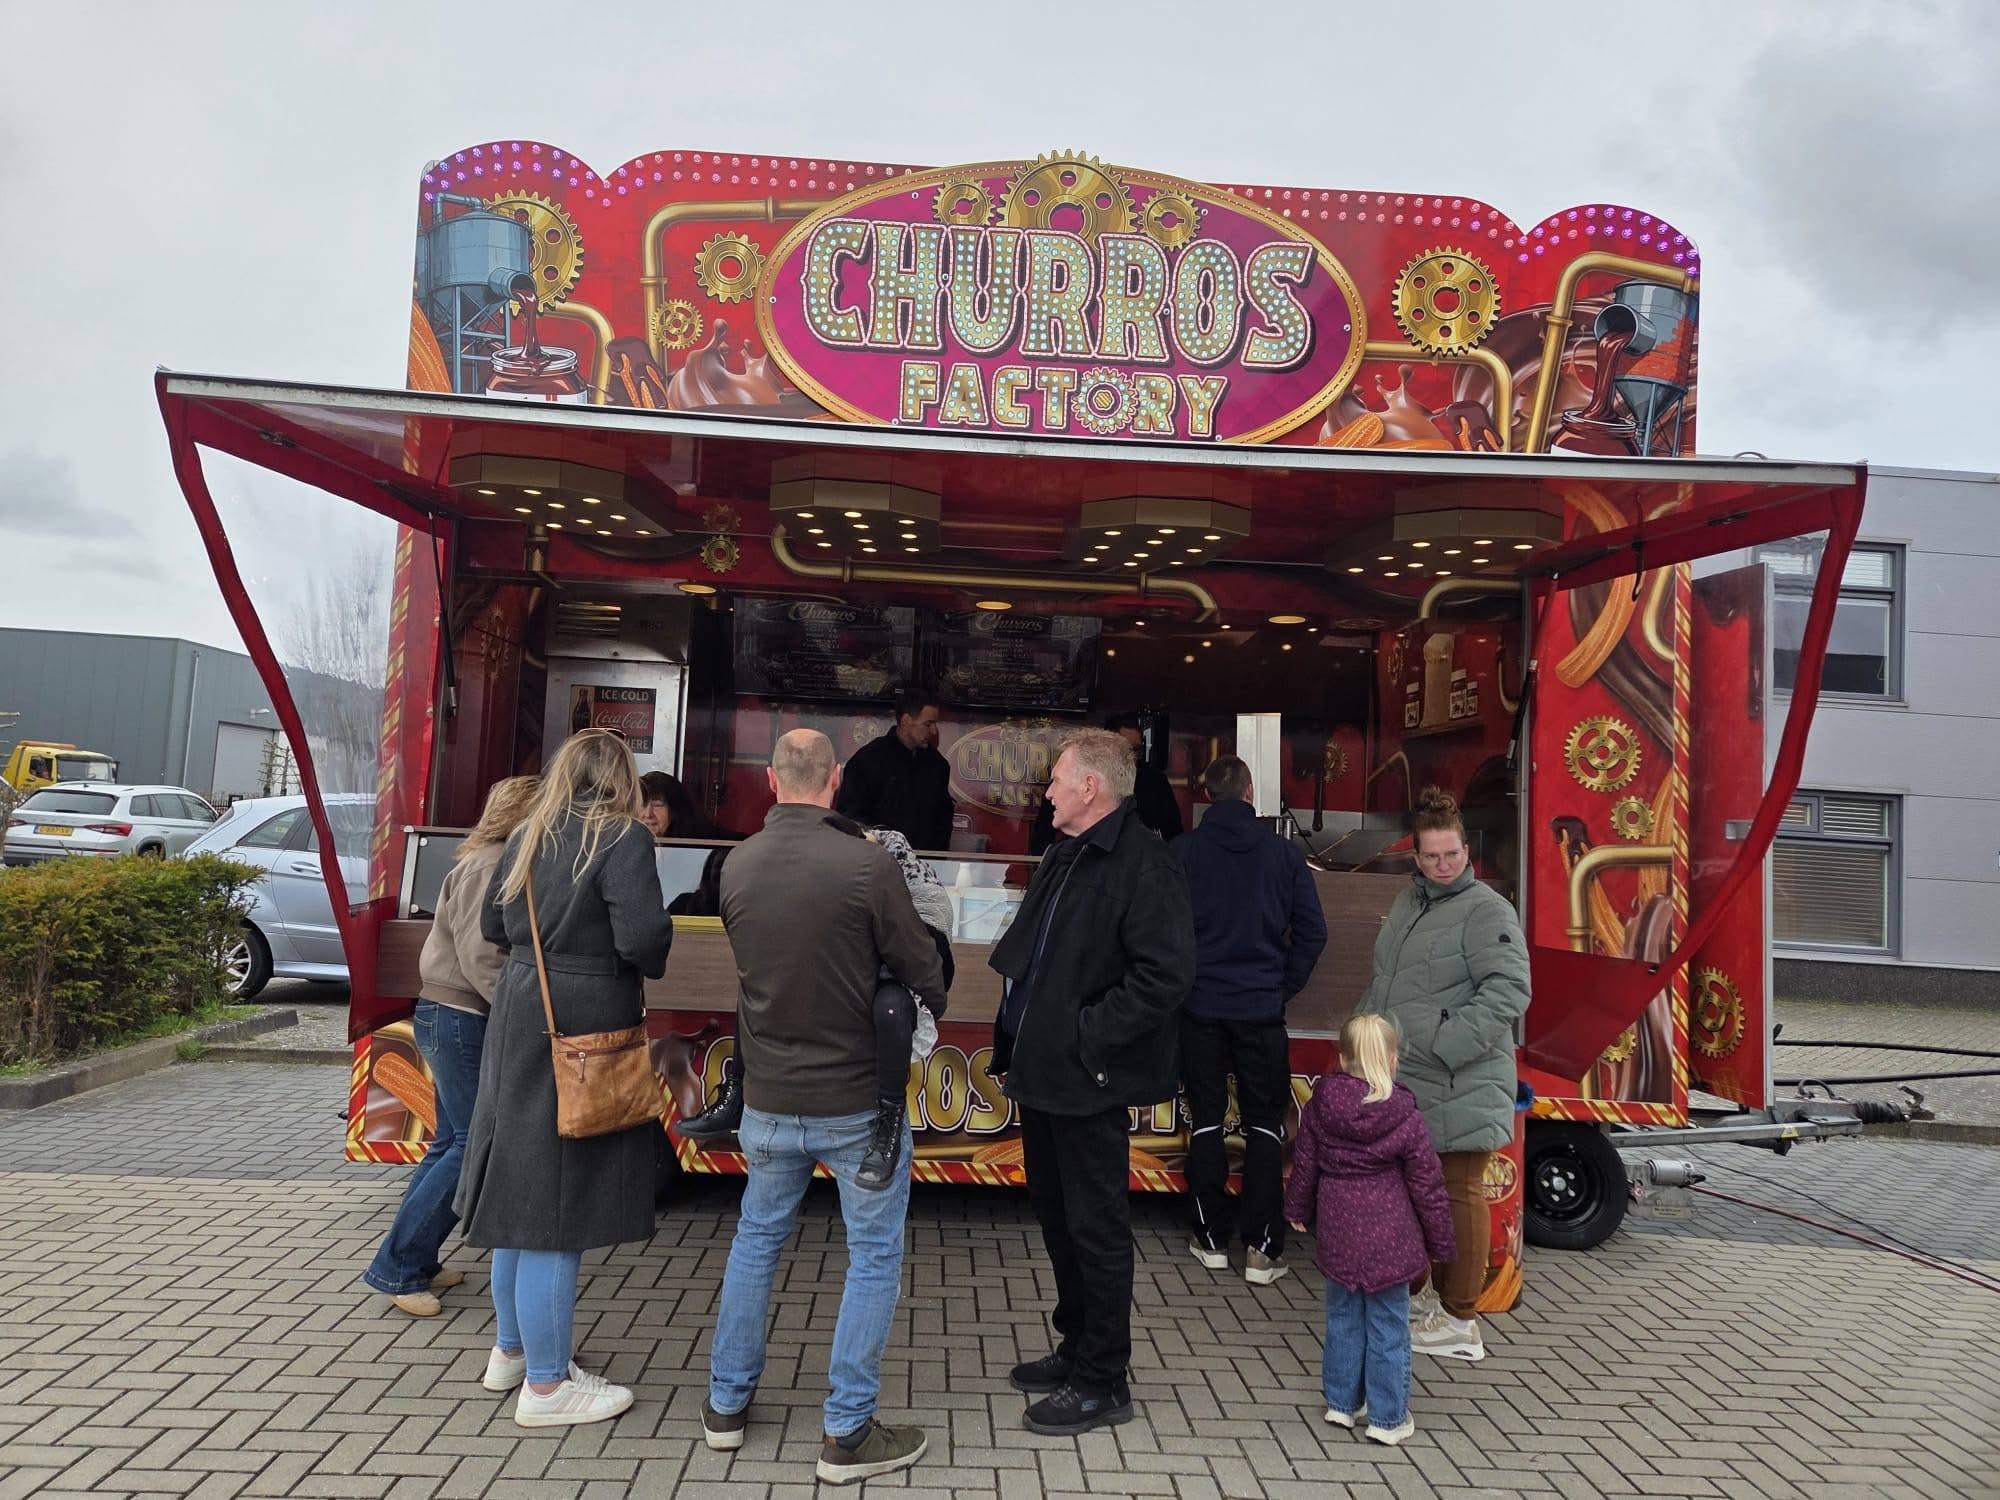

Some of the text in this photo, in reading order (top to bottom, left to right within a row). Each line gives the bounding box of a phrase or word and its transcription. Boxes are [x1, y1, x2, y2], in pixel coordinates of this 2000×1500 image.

[800, 218, 1316, 368] CHURROS
[898, 360, 1230, 438] FACTORY
[601, 689, 650, 702] ICE COLD
[958, 740, 1057, 784] CHUR
